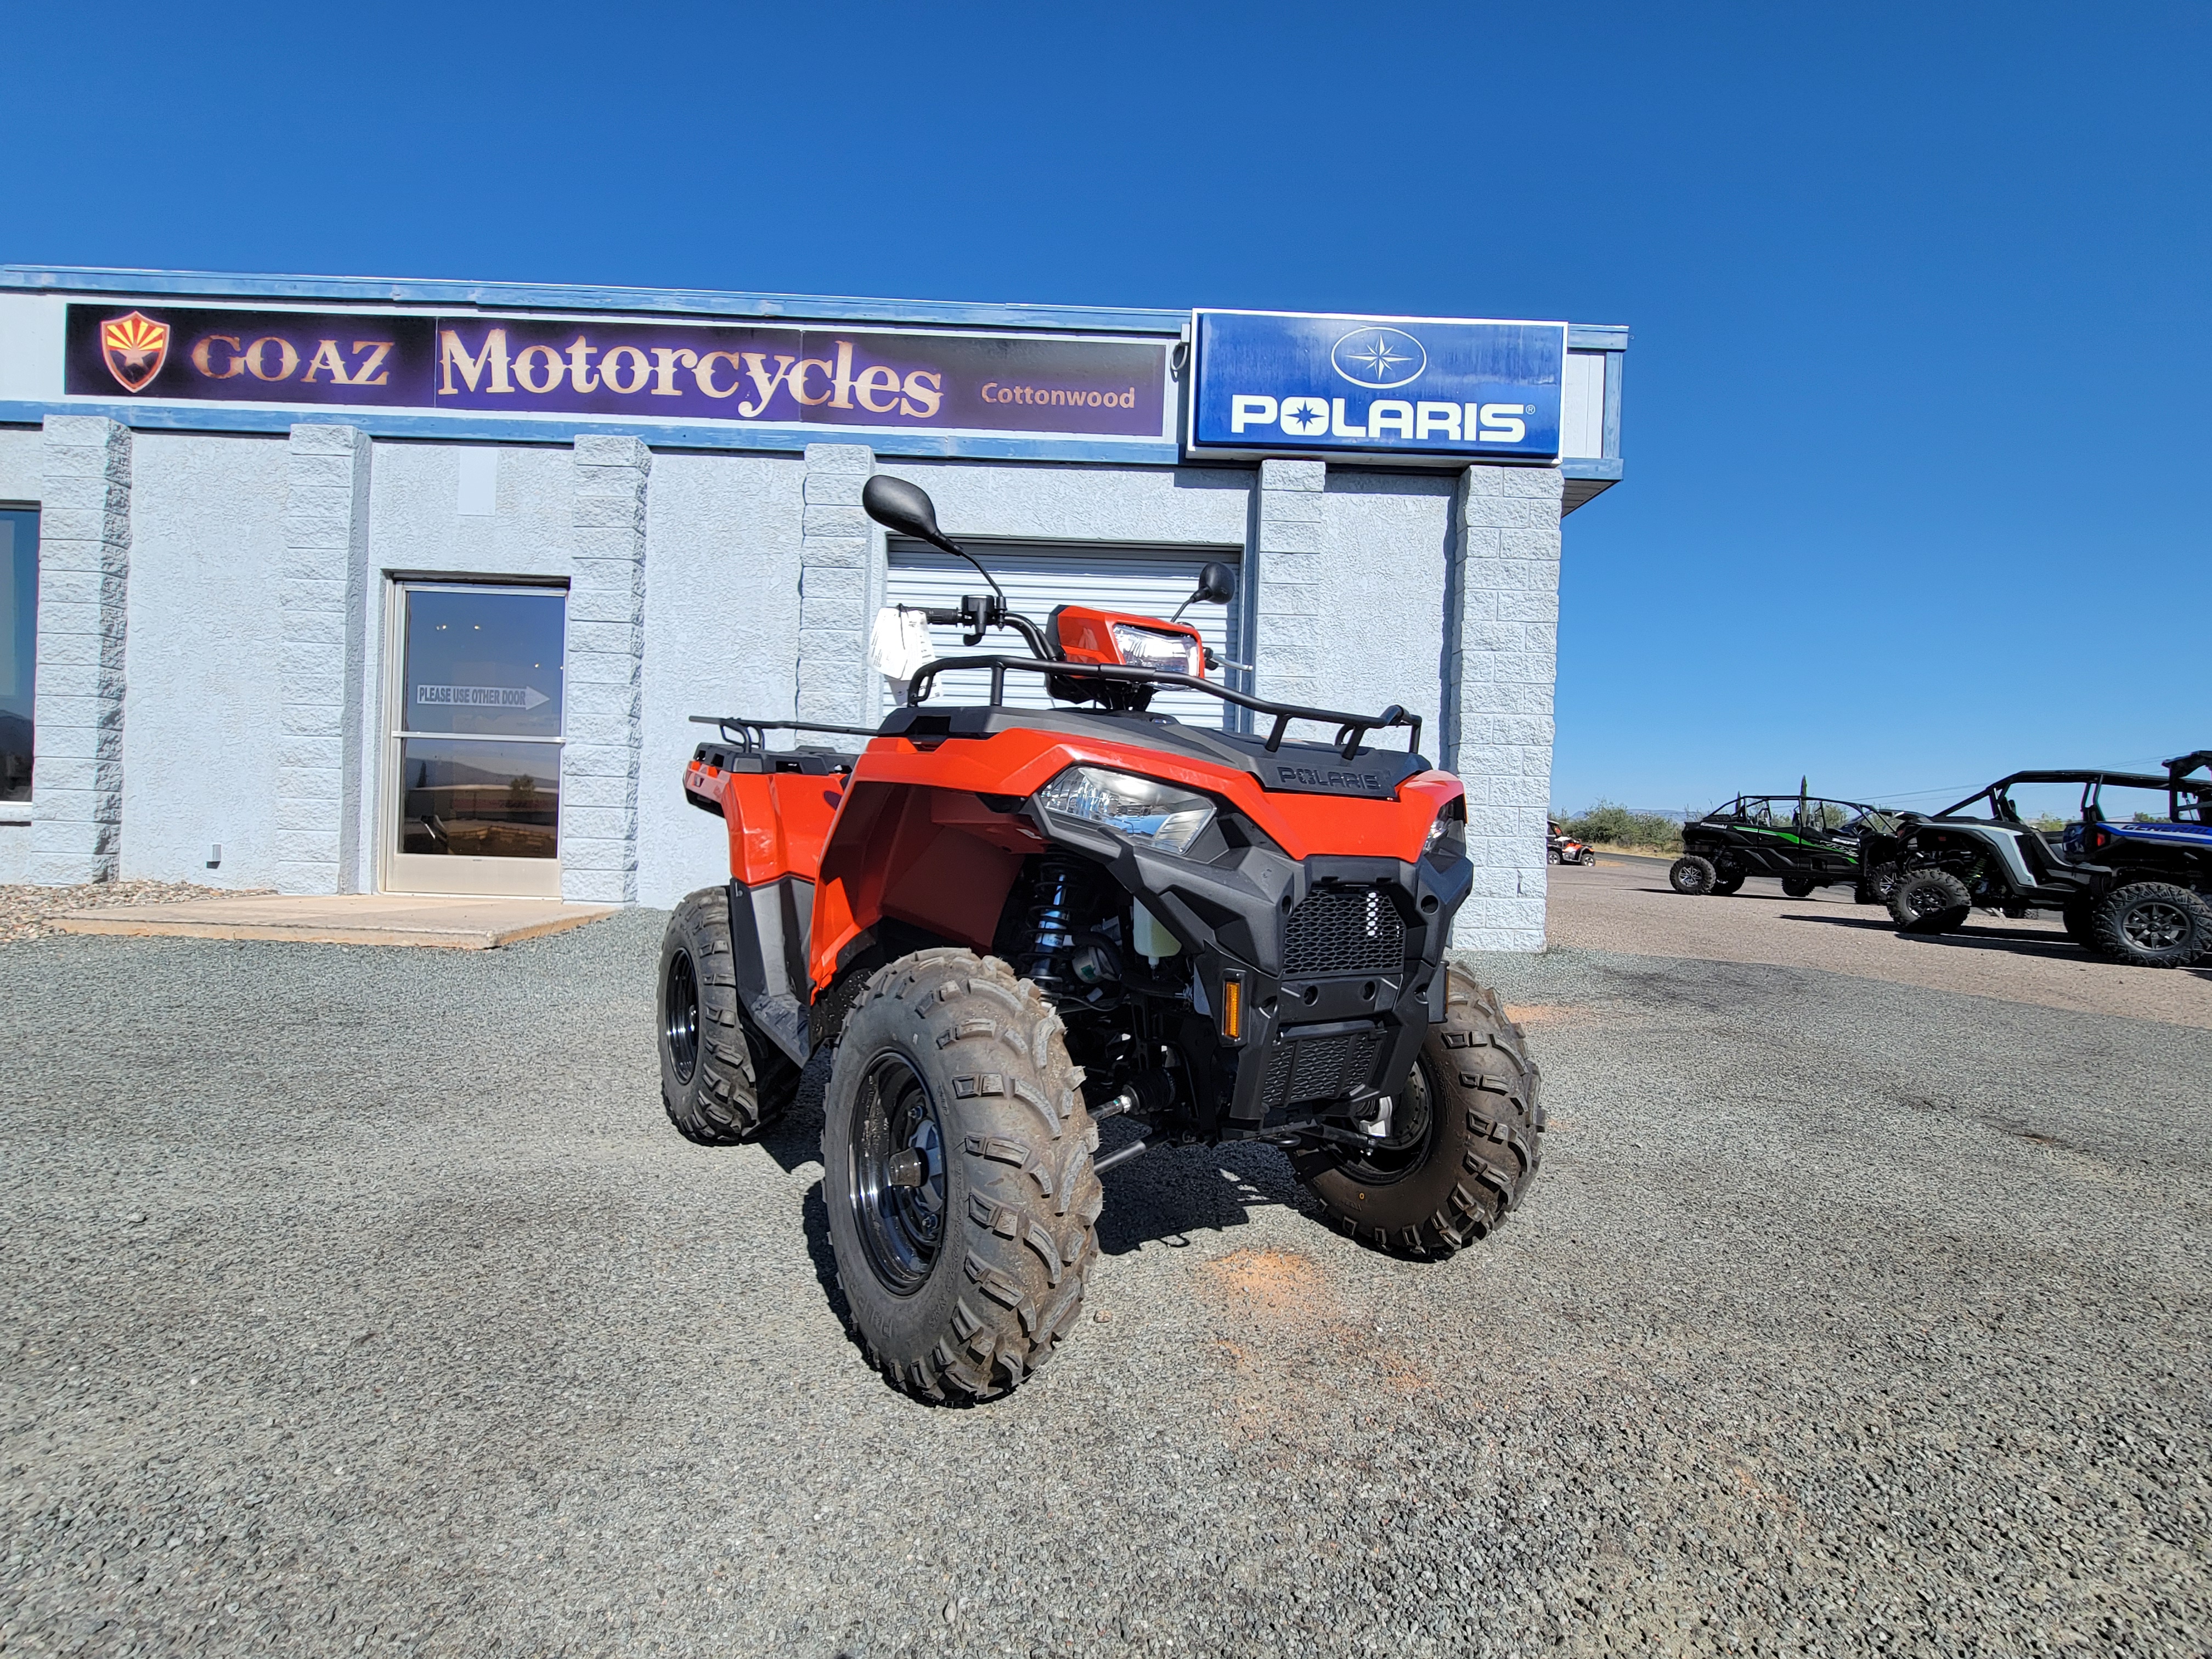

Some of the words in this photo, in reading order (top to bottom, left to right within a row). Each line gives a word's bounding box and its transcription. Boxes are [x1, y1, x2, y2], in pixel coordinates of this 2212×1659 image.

[438, 329, 943, 418] Motorcycles
[981, 382, 1135, 408] Cottonwood
[419, 687, 450, 702] PLEASE
[453, 688, 469, 703] USE
[472, 689, 500, 704] OTHER
[501, 690, 526, 706] DOOR
[1276, 766, 1381, 790] POLARIS
